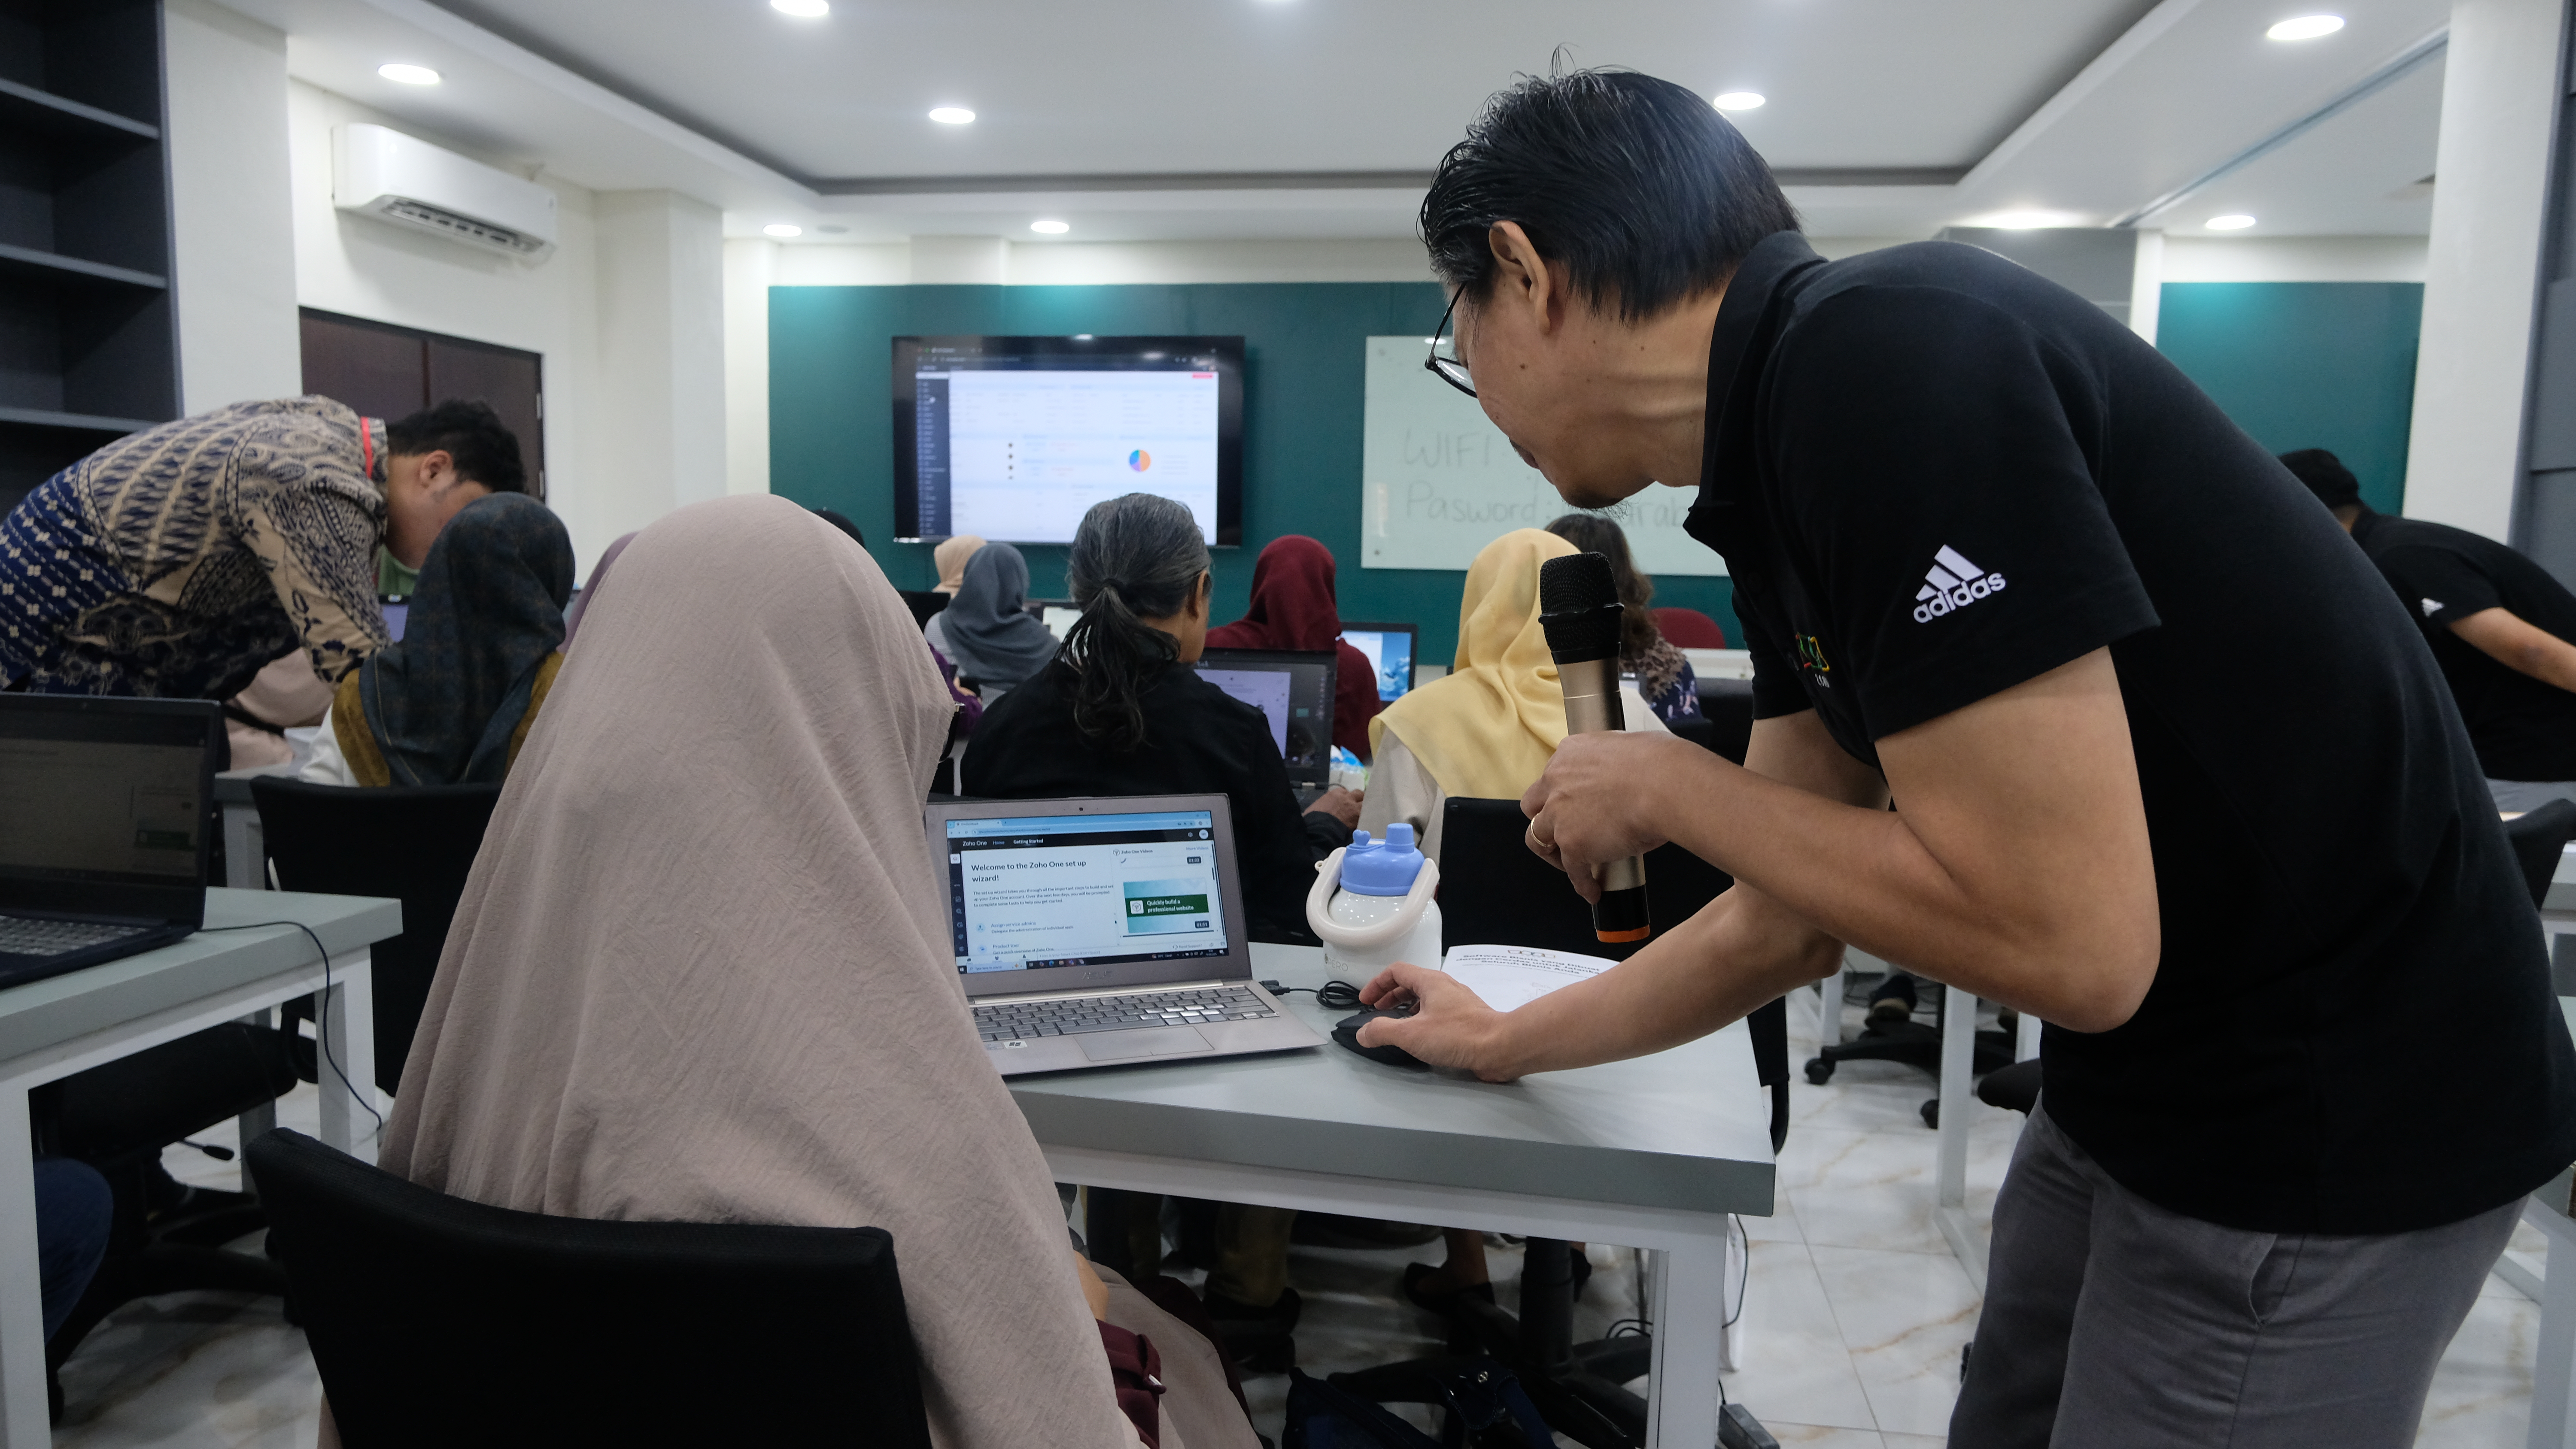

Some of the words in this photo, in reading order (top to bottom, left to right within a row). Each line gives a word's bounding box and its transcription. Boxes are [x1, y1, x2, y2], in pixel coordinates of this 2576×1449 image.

[1403, 427, 1492, 467] WIFI
[1913, 573, 2006, 623] adidas
[1564, 966, 1599, 974] Jalanka
